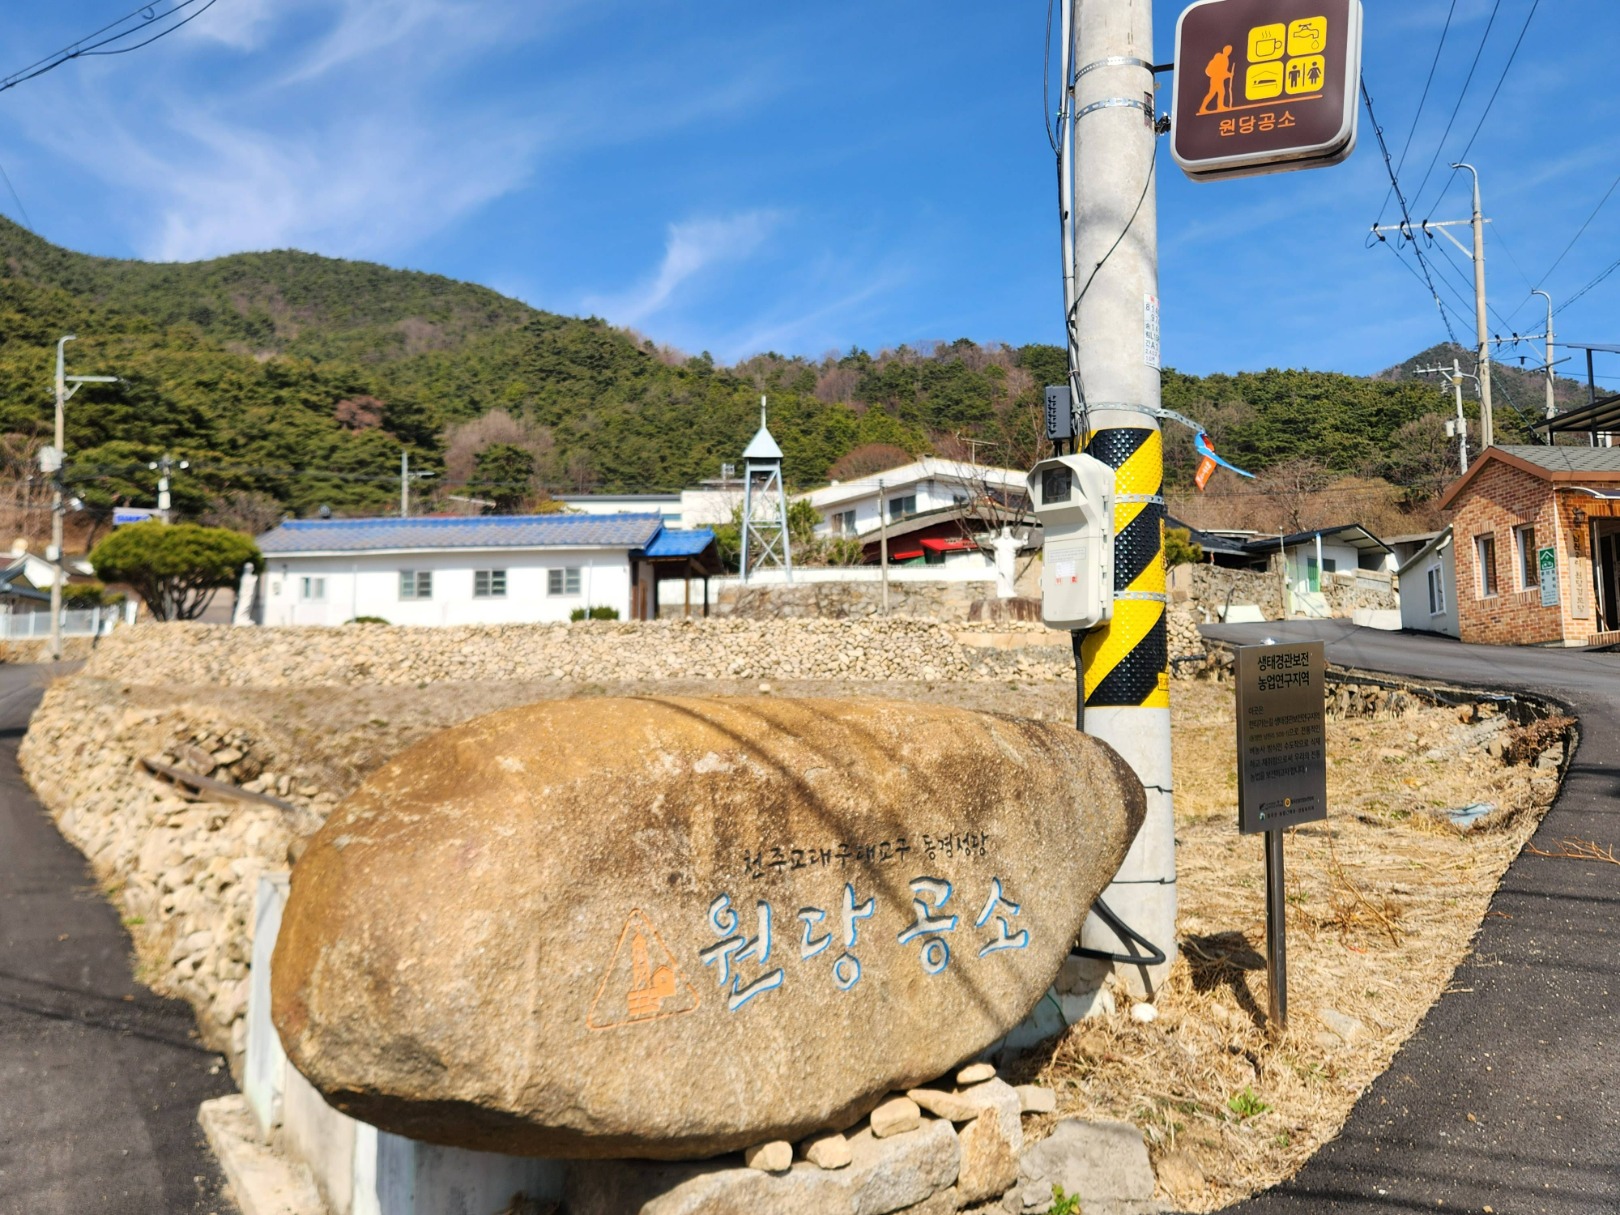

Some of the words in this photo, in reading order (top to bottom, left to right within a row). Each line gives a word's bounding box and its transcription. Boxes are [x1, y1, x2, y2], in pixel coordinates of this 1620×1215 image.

[1219, 111, 1296, 136] 원당공소
[1258, 652, 1309, 671] 생태경관보전
[1258, 671, 1309, 691] 농업연구지역
